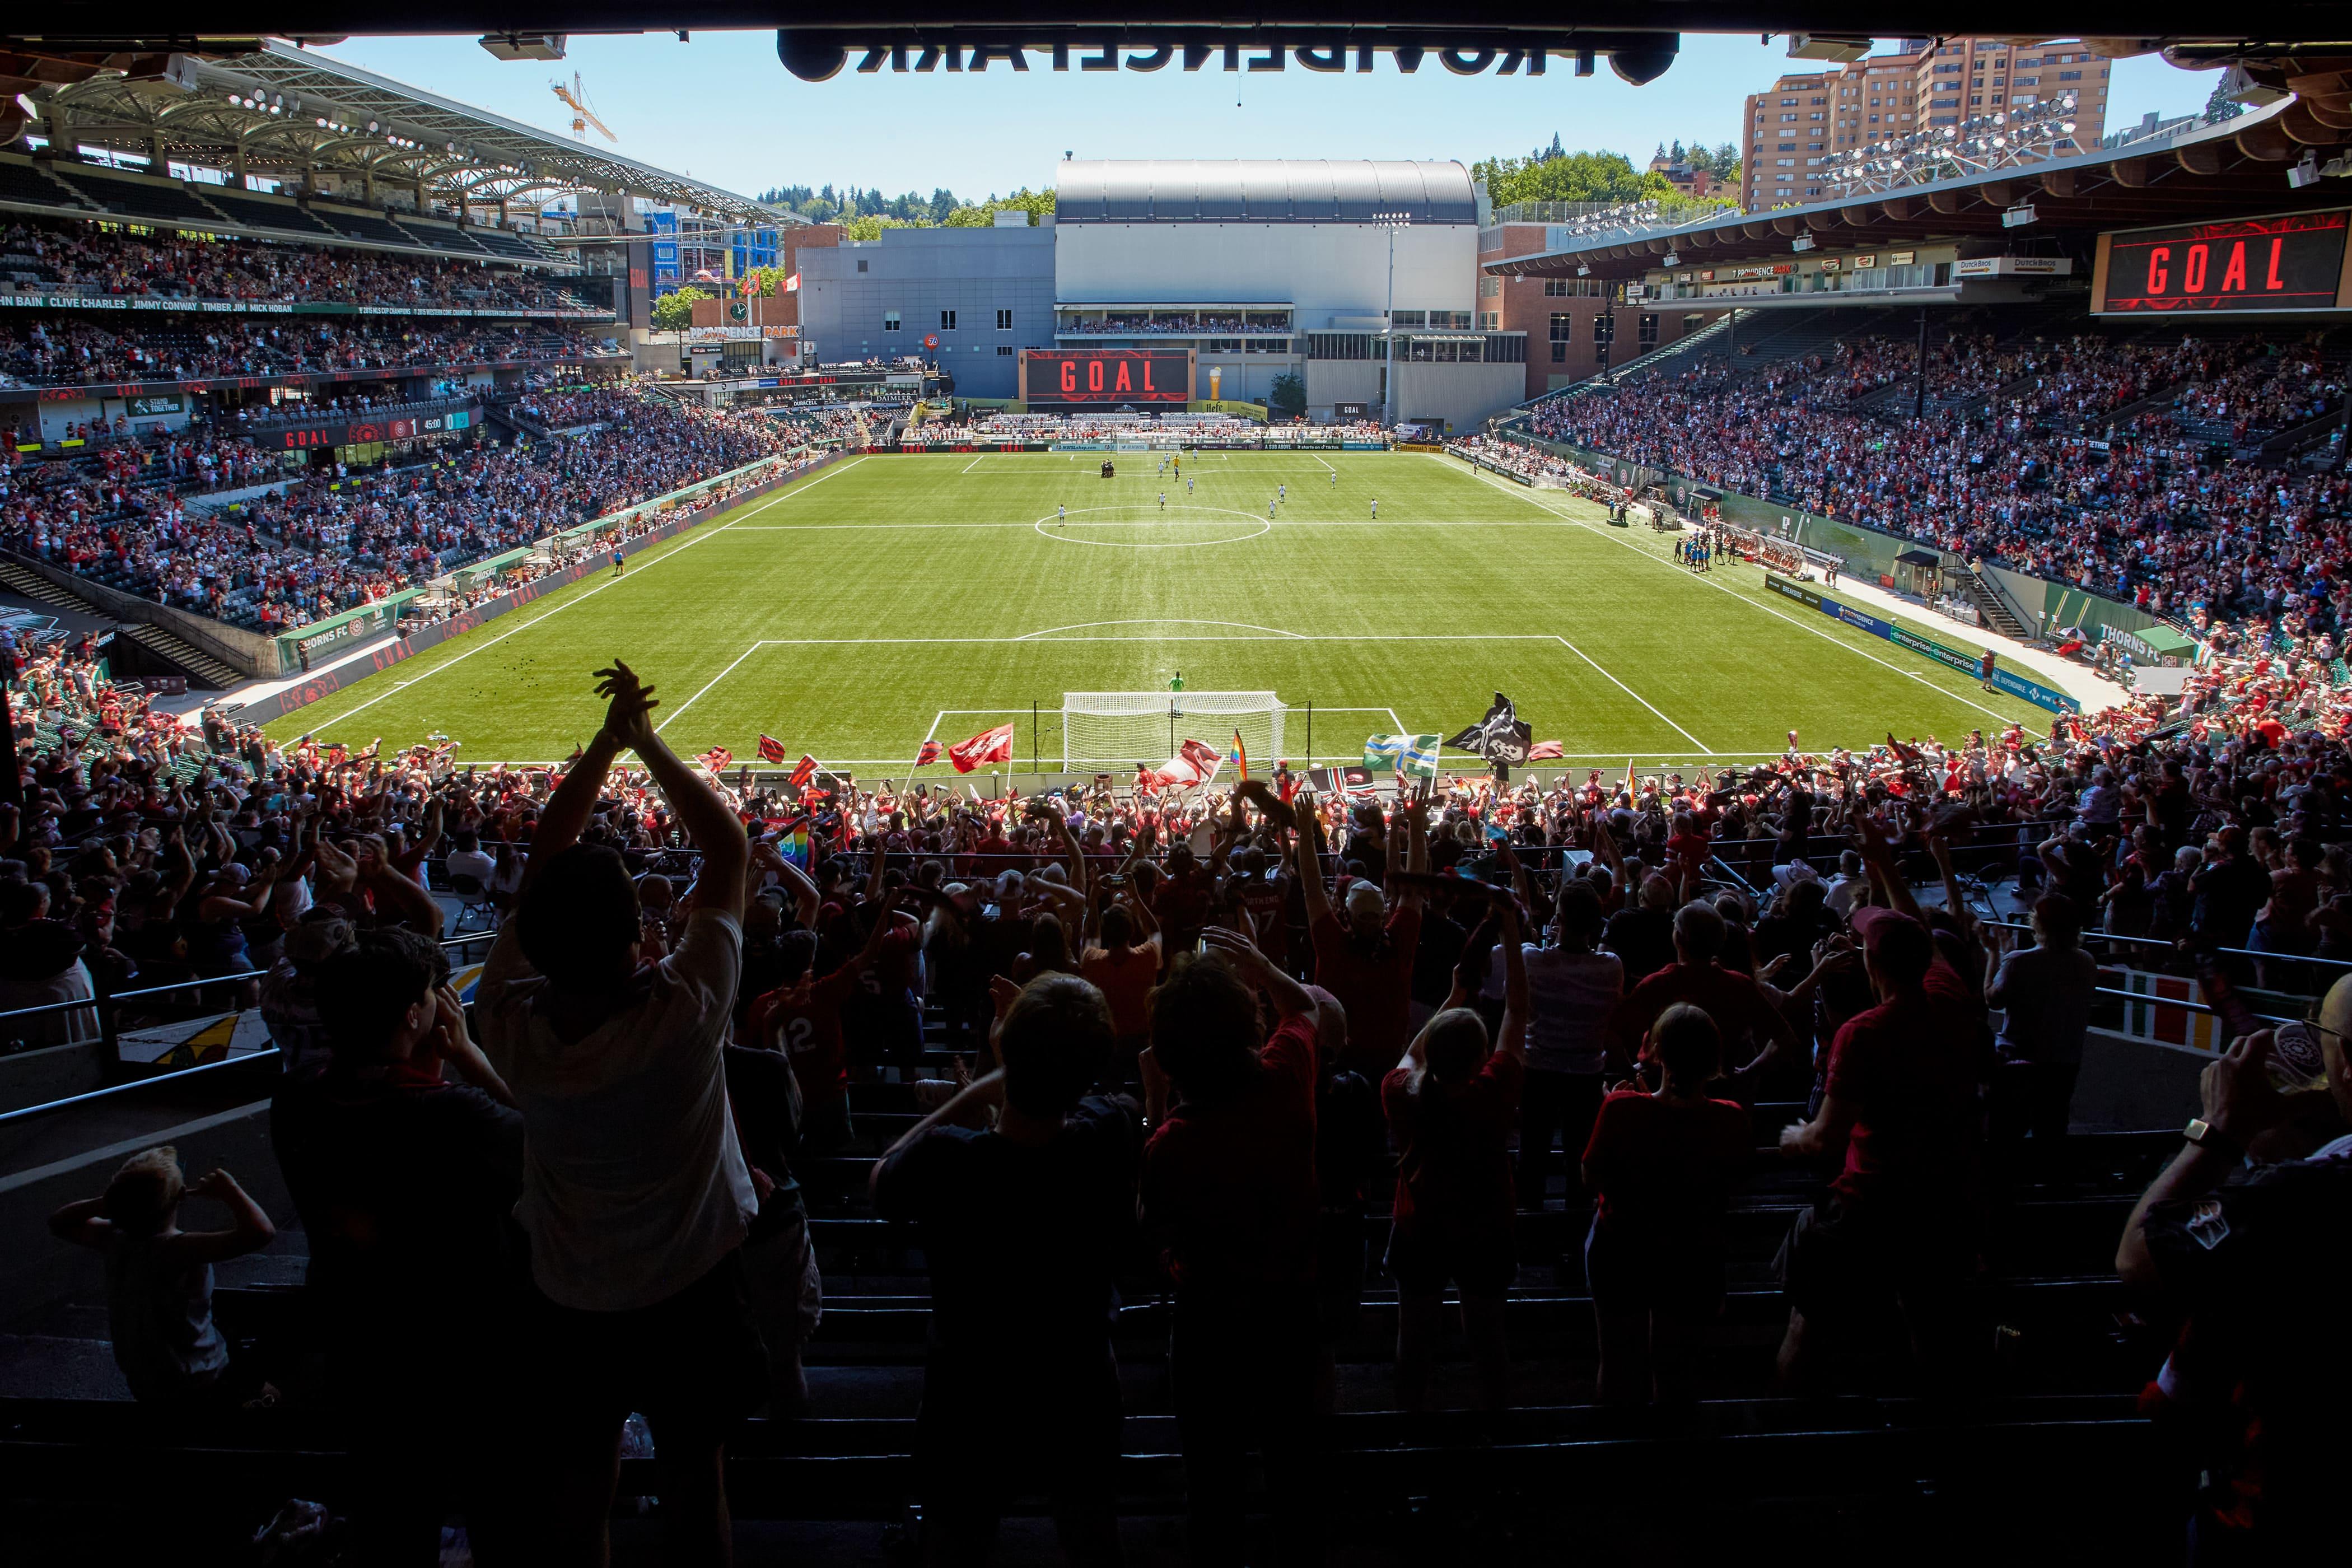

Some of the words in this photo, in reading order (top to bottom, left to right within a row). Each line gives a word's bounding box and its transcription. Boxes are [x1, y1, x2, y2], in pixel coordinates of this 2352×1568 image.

[1737, 265, 1774, 278] PROVIDENCE
[1774, 264, 1791, 274] PARK
[2146, 237, 2284, 295] GOAL
[630, 268, 649, 288] GOAL
[16, 297, 43, 307] BAIN
[50, 298, 80, 308] CLIVE
[82, 299, 127, 309] CHARLES
[133, 300, 161, 310] JIMMY
[162, 302, 197, 311] CONWAY
[202, 302, 232, 312] TIMBER
[250, 304, 268, 312] MICK
[269, 305, 292, 313] HOBAN
[689, 326, 762, 340] PROVIDENCE
[763, 325, 800, 338] PARK
[929, 337, 937, 346] 76
[820, 376, 837, 384] GOAL
[1061, 361, 1155, 392] GOAL
[117, 385, 143, 396] GOAL
[150, 404, 179, 413] TOGETHER
[1206, 401, 1224, 413] Hefe
[410, 418, 417, 436] 1
[425, 418, 441, 430] 45:00
[447, 413, 454, 430] 0
[286, 430, 328, 447] GOAL
[902, 445, 926, 454] GOAL
[1000, 443, 1024, 452] GOAL
[563, 536, 581, 548] THORNS
[580, 533, 587, 542] FC
[470, 566, 497, 584] Alaska
[1782, 585, 1803, 599] BREAKSIDE
[1845, 609, 1874, 626] PROVIDENCE
[96, 631, 115, 648] JERKY
[304, 631, 335, 650] HORNS
[336, 626, 348, 638] FC
[1893, 631, 1931, 652] enterprise
[2101, 623, 2146, 655] THORNS
[371, 637, 415, 670] GOAL
[1934, 648, 1975, 670] enterprise
